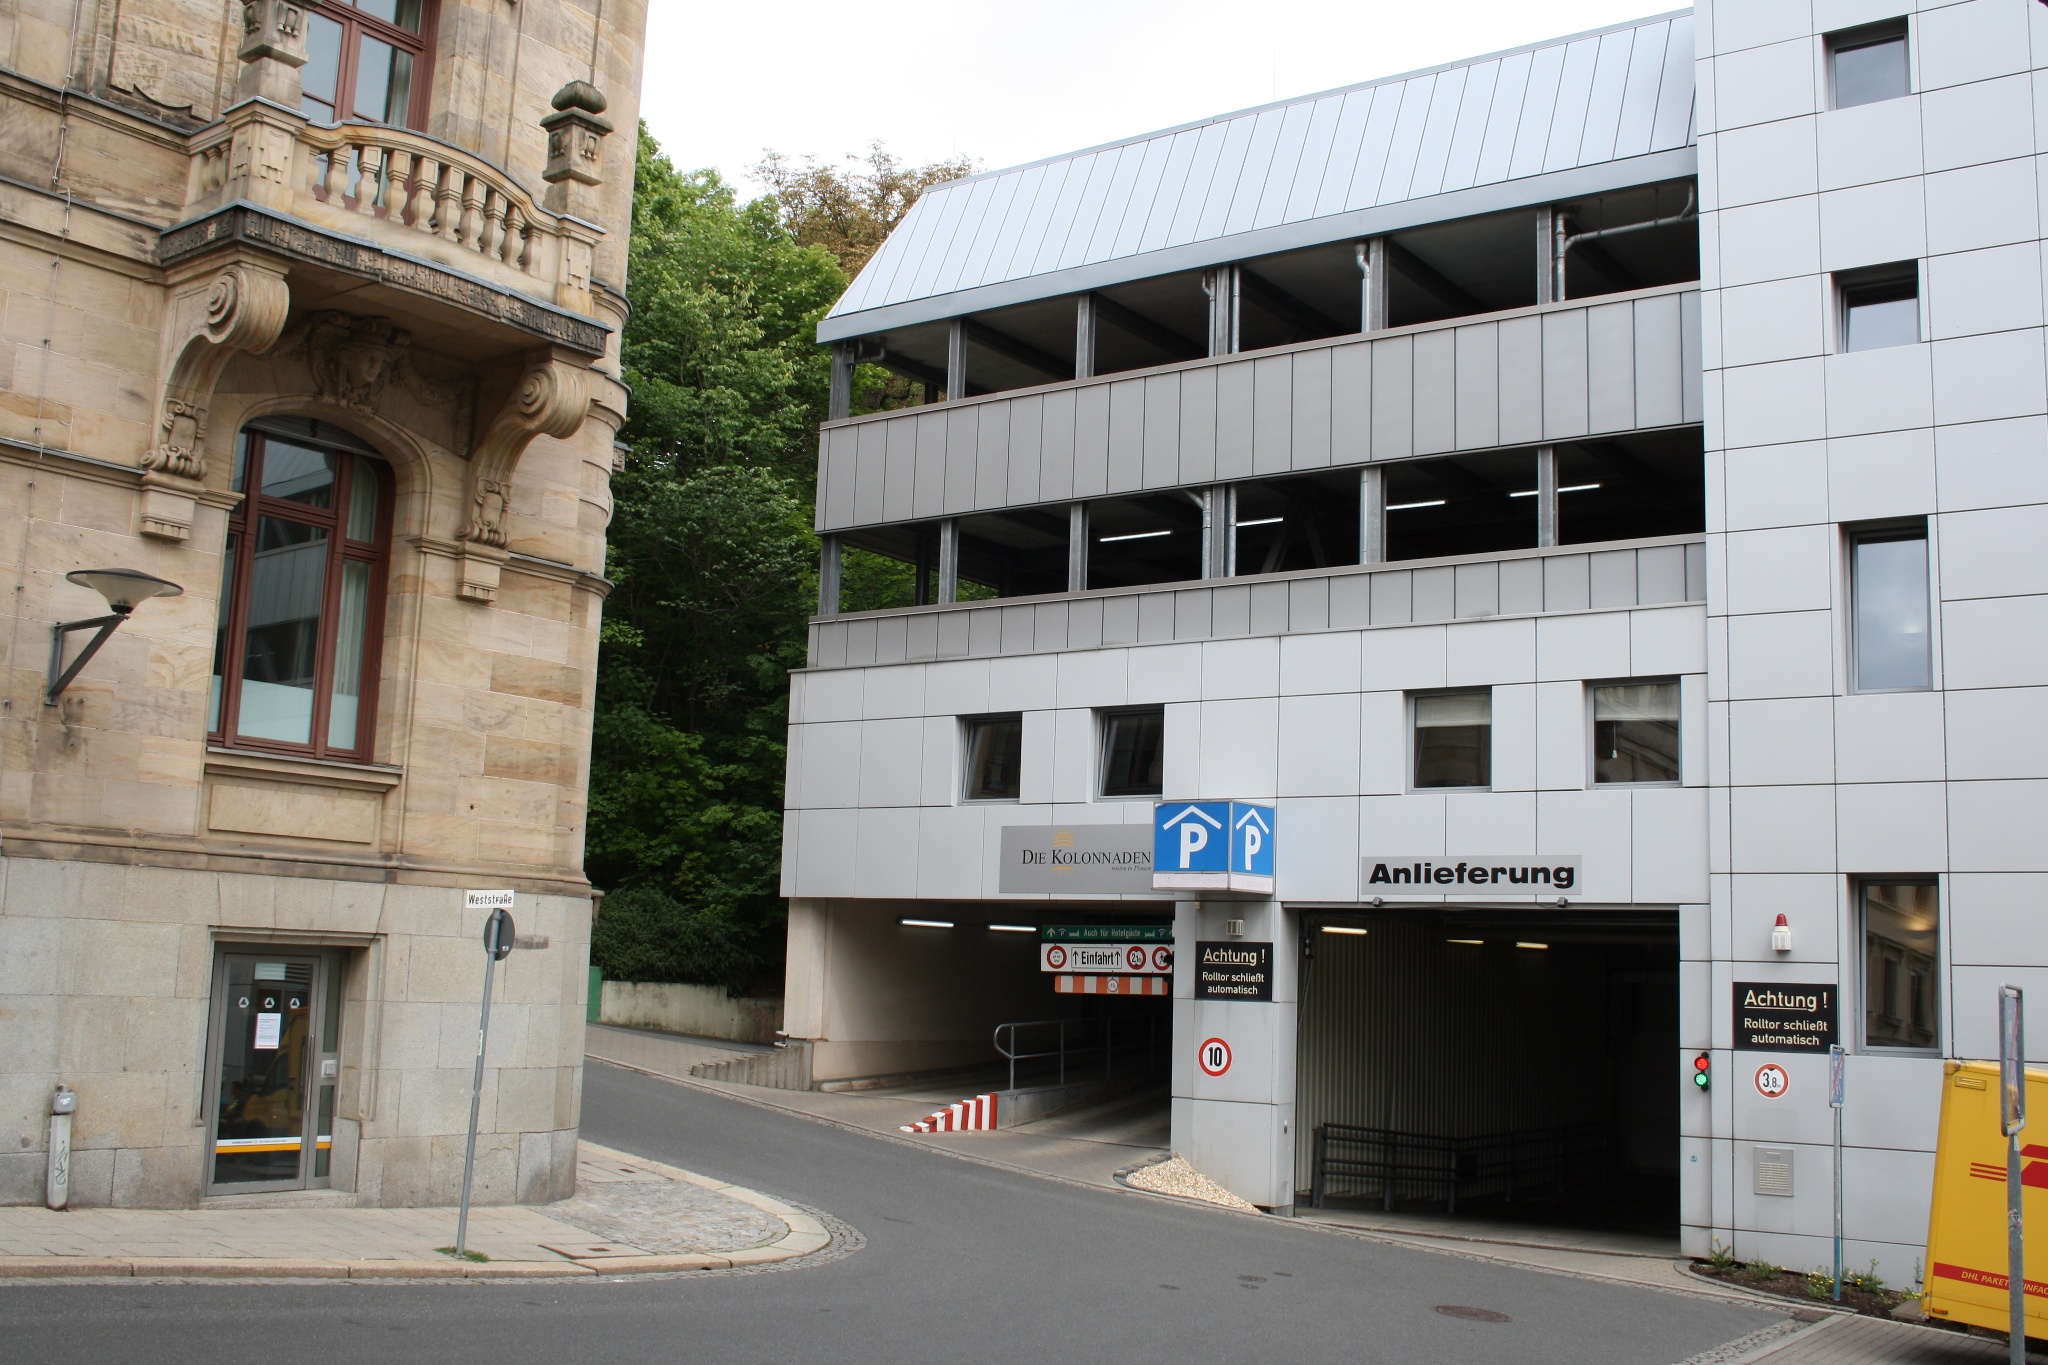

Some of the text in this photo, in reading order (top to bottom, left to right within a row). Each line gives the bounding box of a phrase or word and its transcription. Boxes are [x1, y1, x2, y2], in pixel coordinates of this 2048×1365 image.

[1179, 823, 1208, 869] P
[1245, 825, 1262, 870] P
[1368, 862, 1575, 890] Anlieferung
[468, 893, 512, 905] Weststraße
[1083, 928, 1098, 937] Auch
[1100, 928, 1109, 937] für
[1111, 928, 1141, 939] Hotelgäste
[1081, 951, 1114, 965] Einfahrt
[1203, 948, 1265, 966] Achtung !
[1202, 971, 1265, 983] Rolltor schließt
[1207, 984, 1258, 995] automatisch
[1744, 989, 1828, 1012] Achtung !
[1744, 1018, 1828, 1032] Rolltor schließt
[1751, 1034, 1820, 1046] automatisch
[1208, 1046, 1222, 1067] 10
[1961, 1271, 2048, 1295] DHL PAKET INFAC
